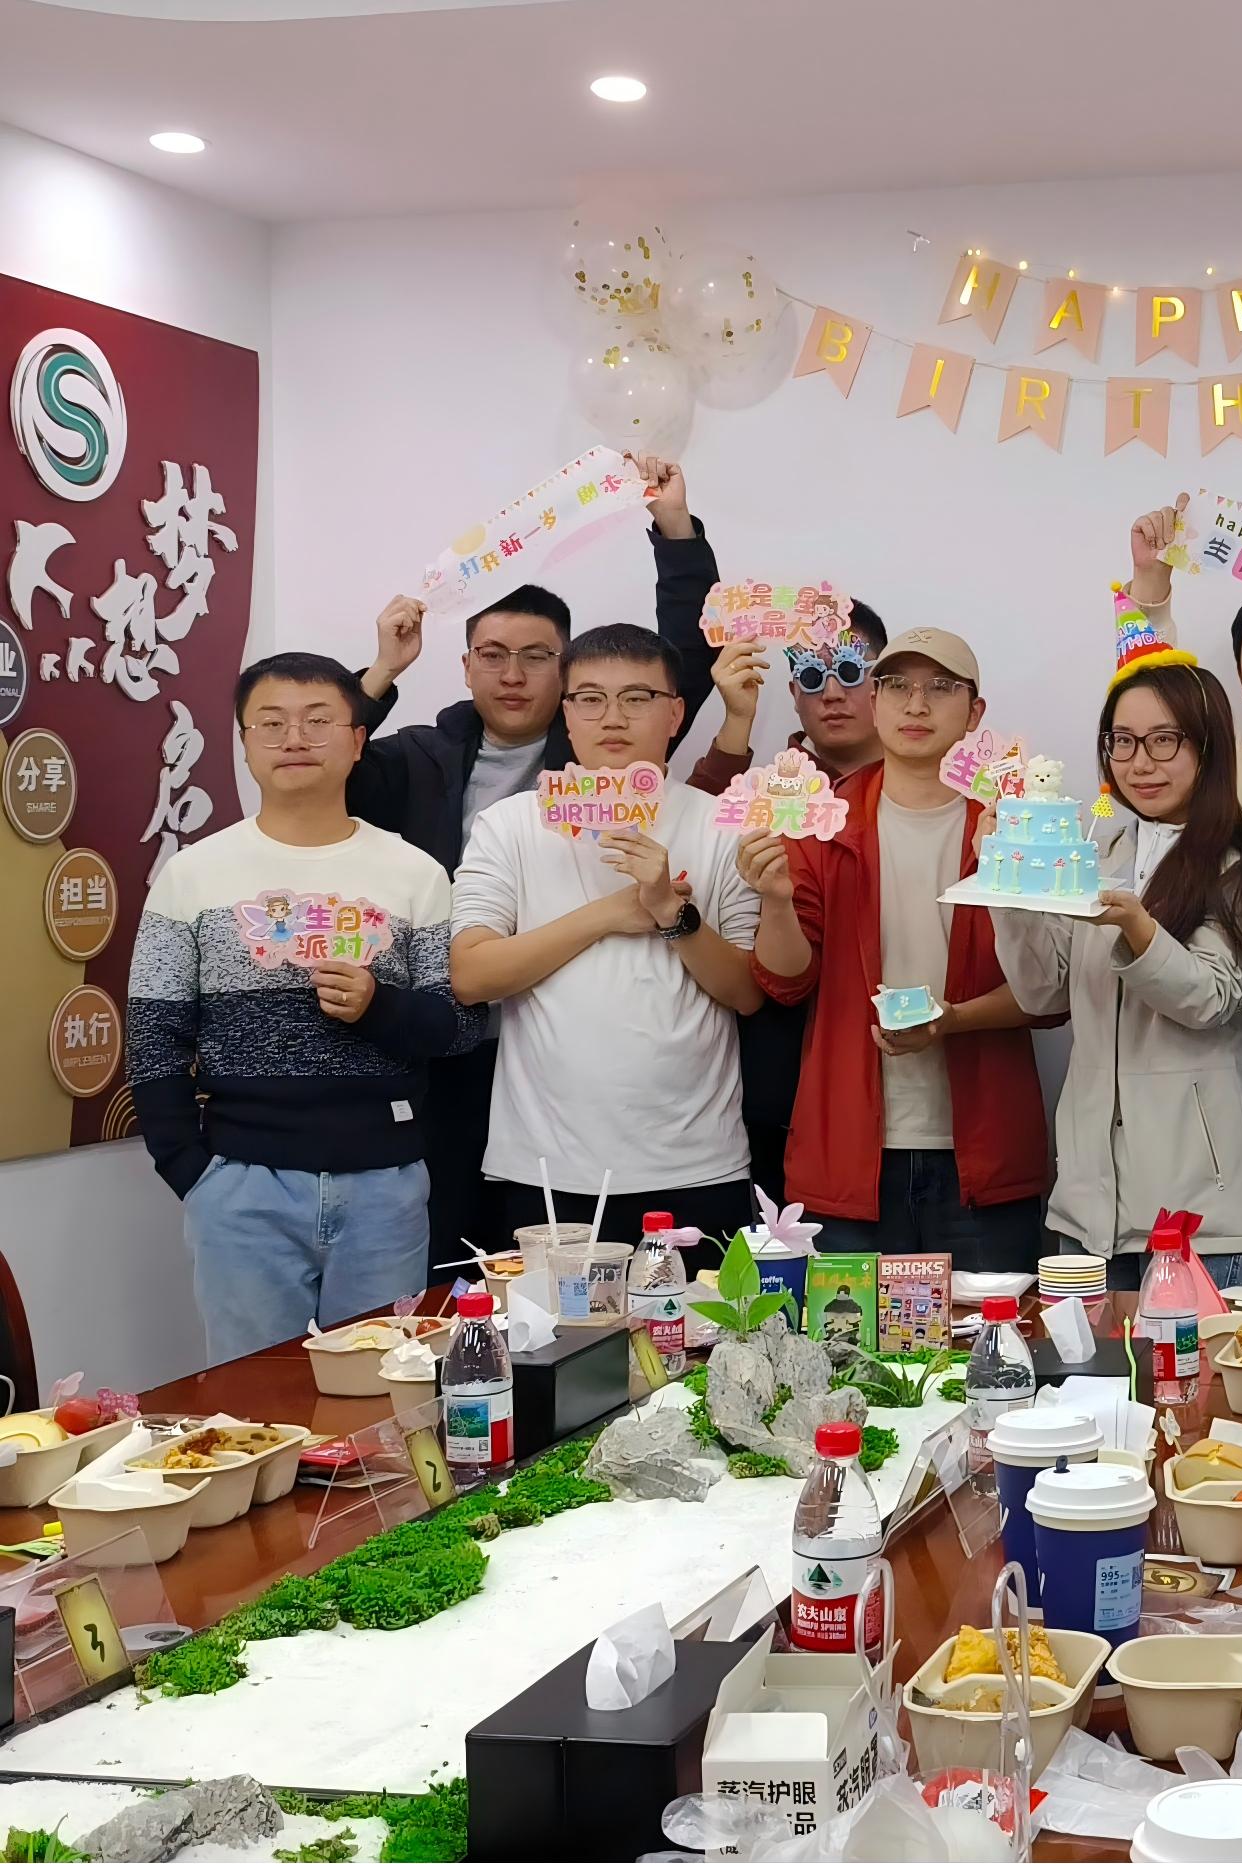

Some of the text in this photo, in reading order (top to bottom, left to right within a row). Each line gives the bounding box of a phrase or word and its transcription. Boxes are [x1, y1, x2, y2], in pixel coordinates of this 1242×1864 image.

[732, 609, 813, 644] 我最大
[0, 642, 17, 678] 业
[17, 756, 66, 792] 分享
[548, 776, 626, 796] HAPPY
[26, 802, 57, 813] SHARE
[547, 803, 660, 823] BIRTHDAY
[715, 798, 844, 833] 主角光环
[60, 875, 107, 911] 担当
[305, 904, 363, 933] 生日
[295, 933, 365, 960] 派对
[64, 1012, 111, 1049] 执行
[881, 1261, 945, 1276] BRICKS
[425, 1460, 442, 1493] 2
[1101, 1570, 1120, 1581] 995
[797, 1602, 847, 1622] 农夫山泉
